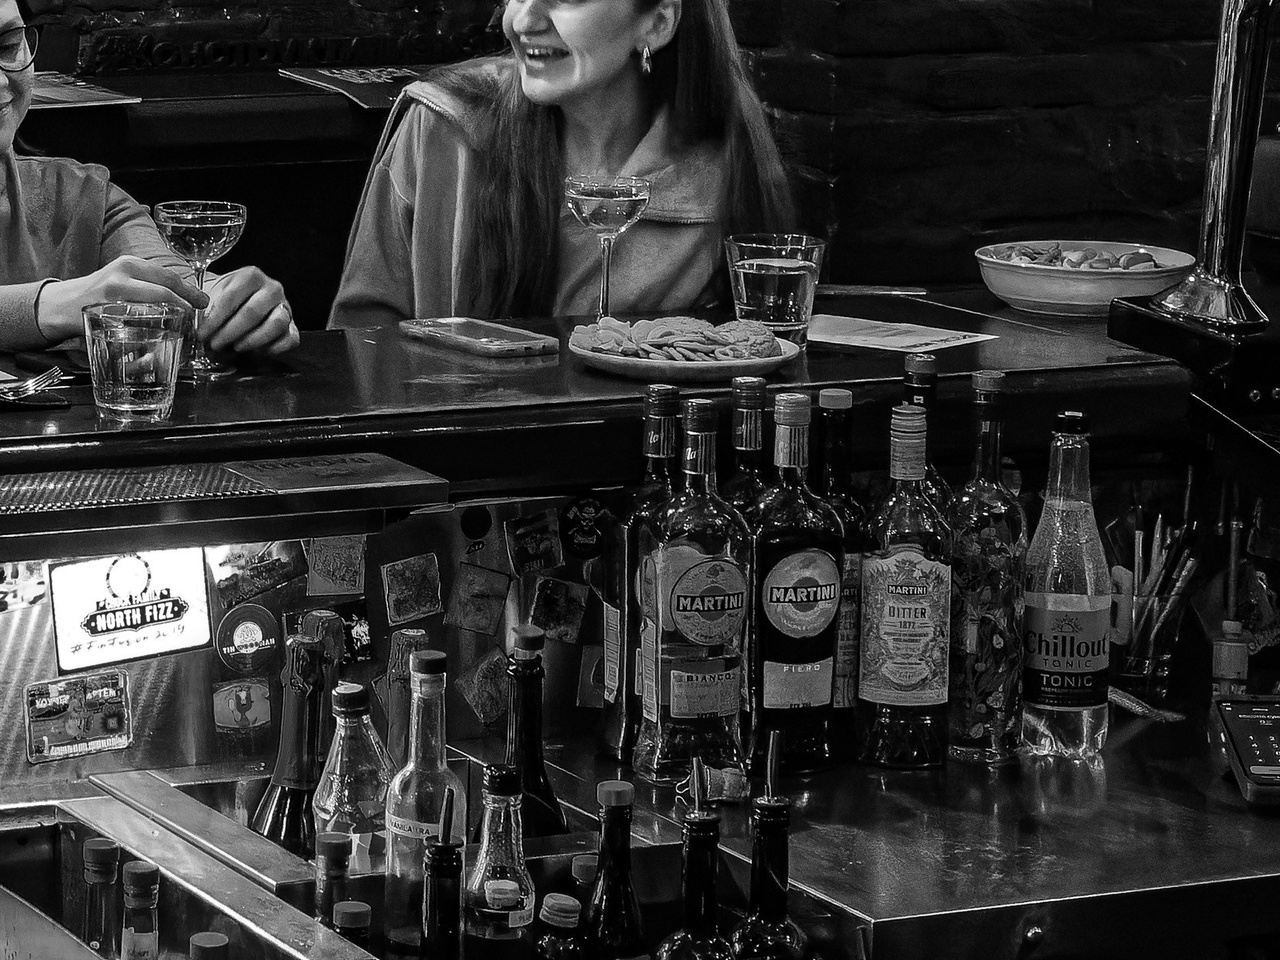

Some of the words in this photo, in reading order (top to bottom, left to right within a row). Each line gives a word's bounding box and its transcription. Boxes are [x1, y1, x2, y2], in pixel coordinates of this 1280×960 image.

[771, 584, 836, 603] MARTINI
[887, 585, 927, 595] MARTINI
[678, 593, 743, 611] MARTINI
[96, 606, 141, 632] NORTH
[145, 601, 174, 623] FIZZ
[888, 605, 927, 619] BITTER
[222, 645, 236, 654] TIN
[1024, 629, 1109, 658] Chillout
[783, 664, 821, 673] FIERO
[1042, 658, 1093, 669] TONIC
[686, 672, 732, 682] BIANCO
[1040, 673, 1094, 688] TONIC
